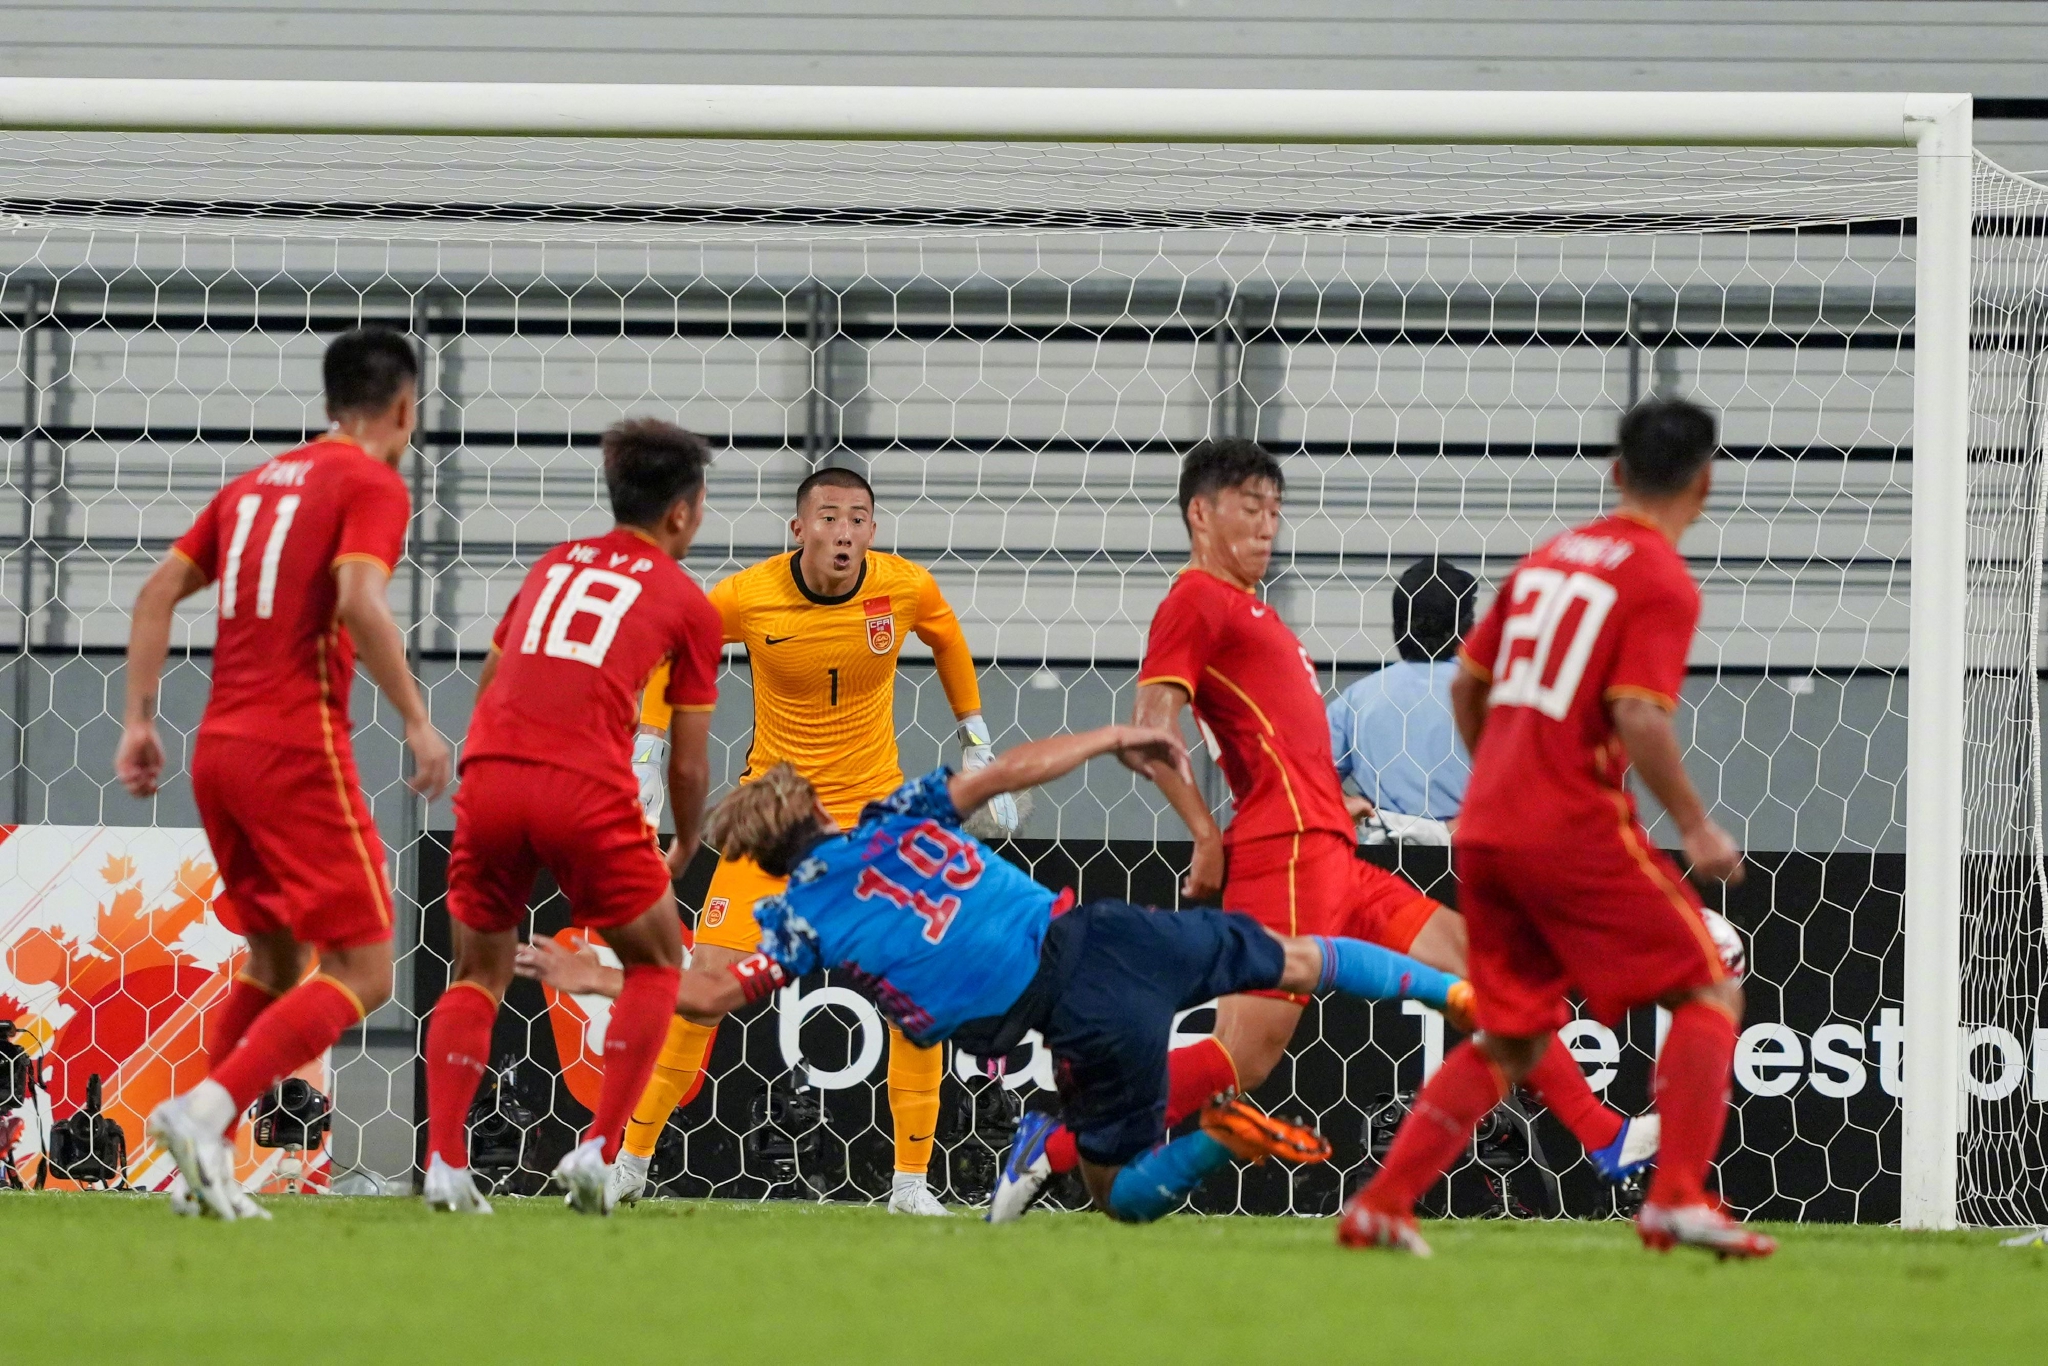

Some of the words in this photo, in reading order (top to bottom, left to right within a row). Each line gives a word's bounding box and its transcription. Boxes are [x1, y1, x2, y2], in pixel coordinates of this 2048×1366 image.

[221, 494, 299, 619] 11
[629, 558, 653, 574] P
[521, 563, 642, 668] 18
[870, 618, 890, 629] CFA
[1488, 567, 1618, 721] 20
[828, 669, 838, 705] 1
[853, 818, 985, 945] 19
[1656, 1003, 1903, 1098] est
